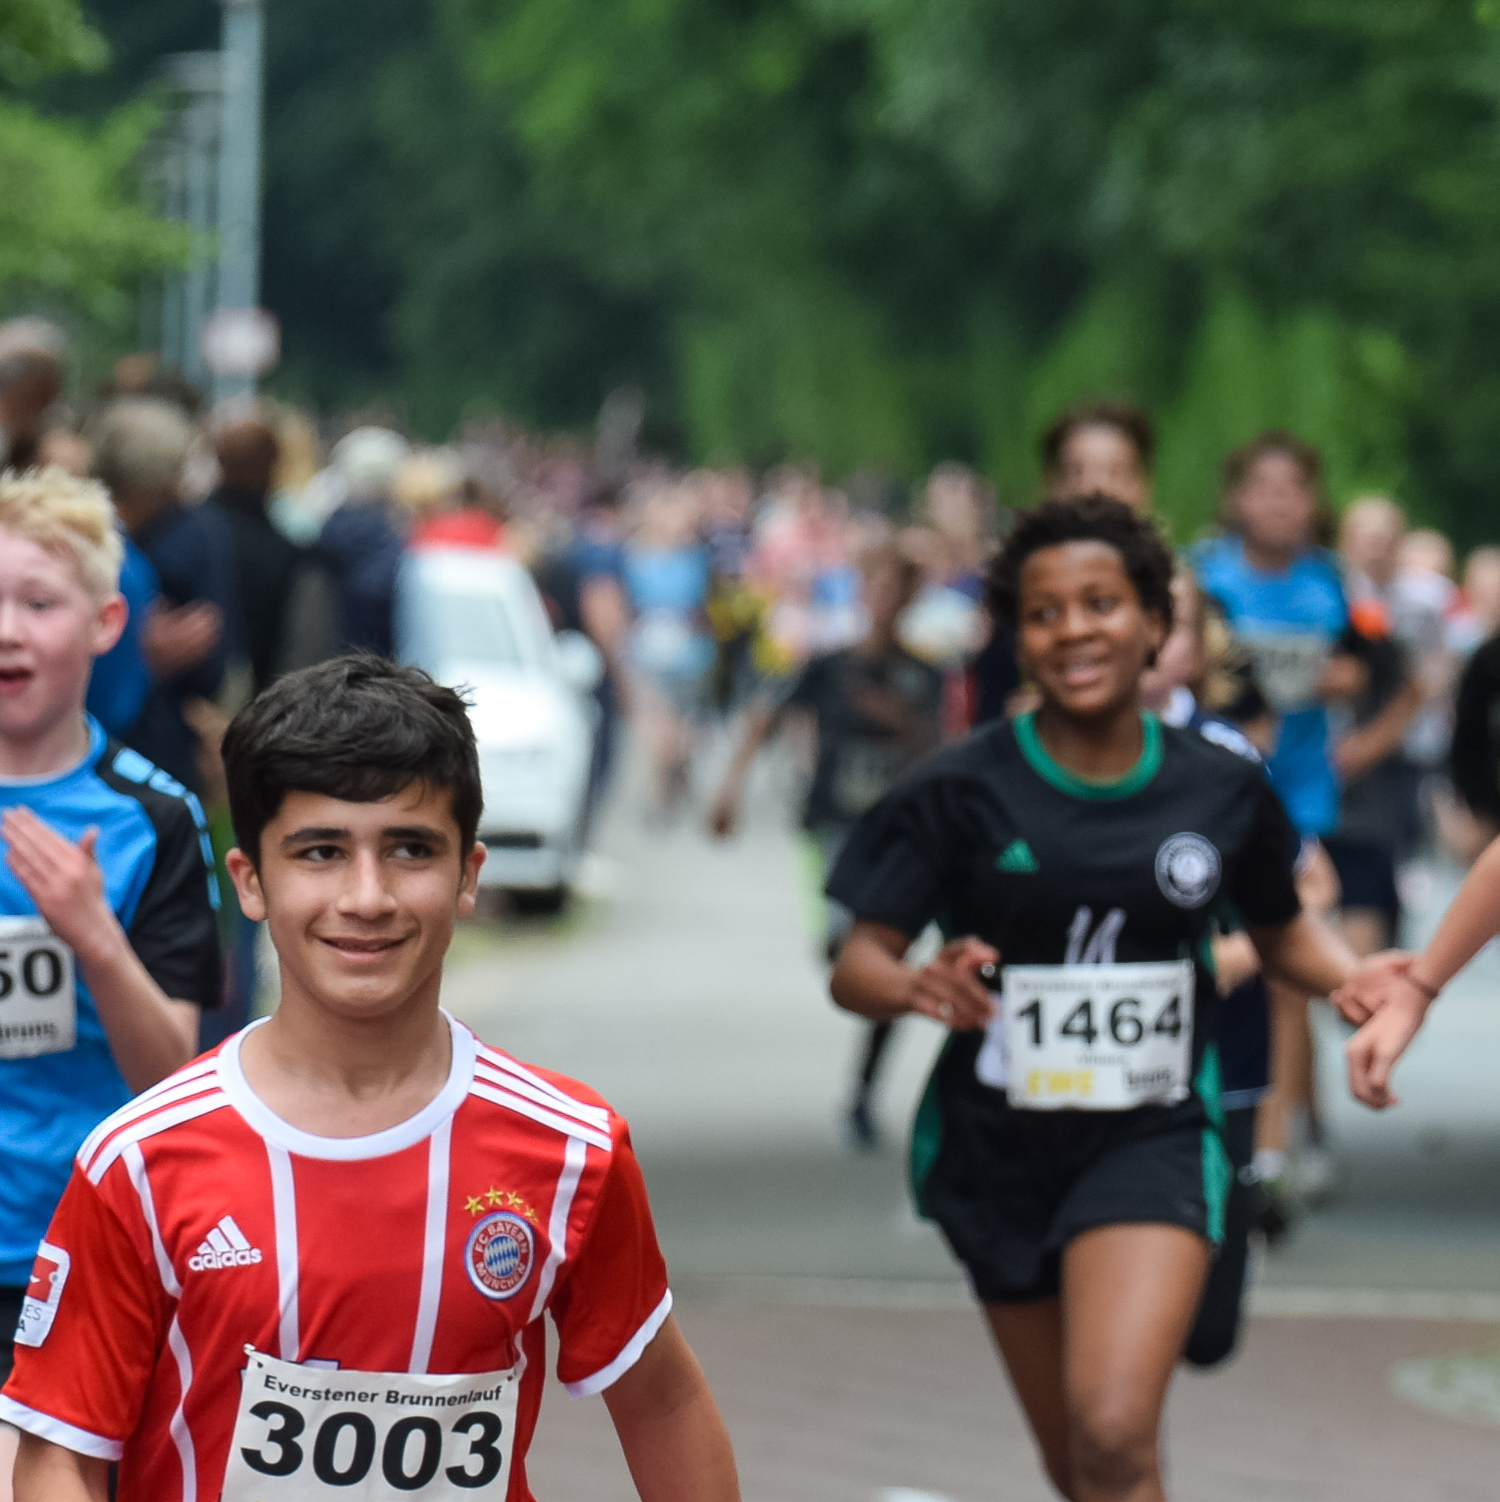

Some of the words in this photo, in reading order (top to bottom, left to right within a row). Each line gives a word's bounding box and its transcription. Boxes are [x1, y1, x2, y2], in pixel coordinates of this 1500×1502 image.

[1017, 994, 1182, 1046] 1464
[474, 1233, 489, 1253] FC
[487, 1222, 529, 1253] BAYERN
[188, 1247, 263, 1271] adidas
[263, 1374, 379, 1404] Everstener
[385, 1385, 503, 1407] Brunnenlauf
[240, 1400, 503, 1491] 3003
